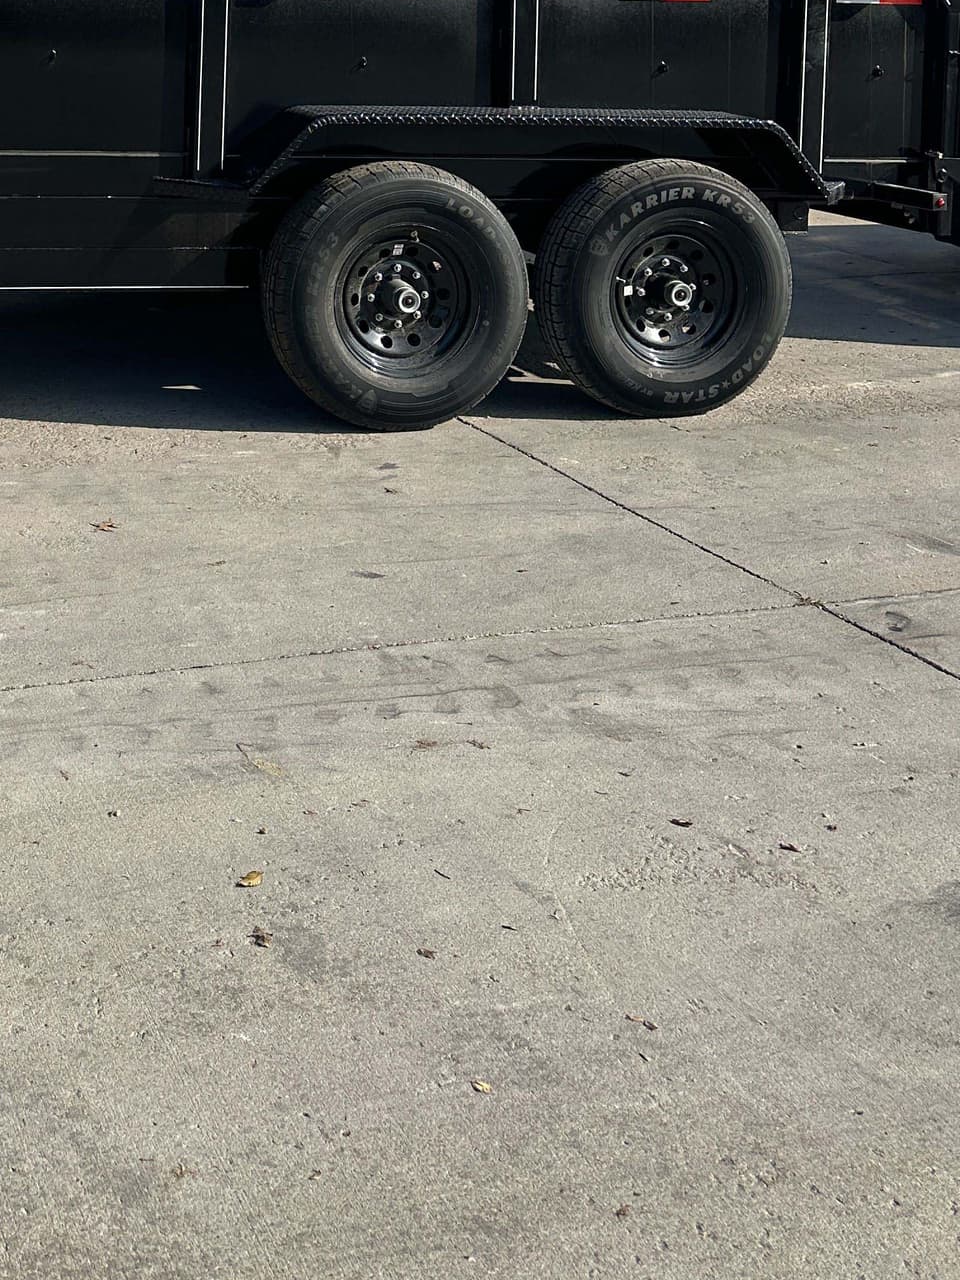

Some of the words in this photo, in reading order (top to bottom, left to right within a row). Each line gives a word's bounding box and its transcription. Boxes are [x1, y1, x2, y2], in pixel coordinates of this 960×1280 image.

[444, 197, 498, 241] LOAD
[604, 186, 696, 243] KARRIER
[702, 188, 756, 224] KR53
